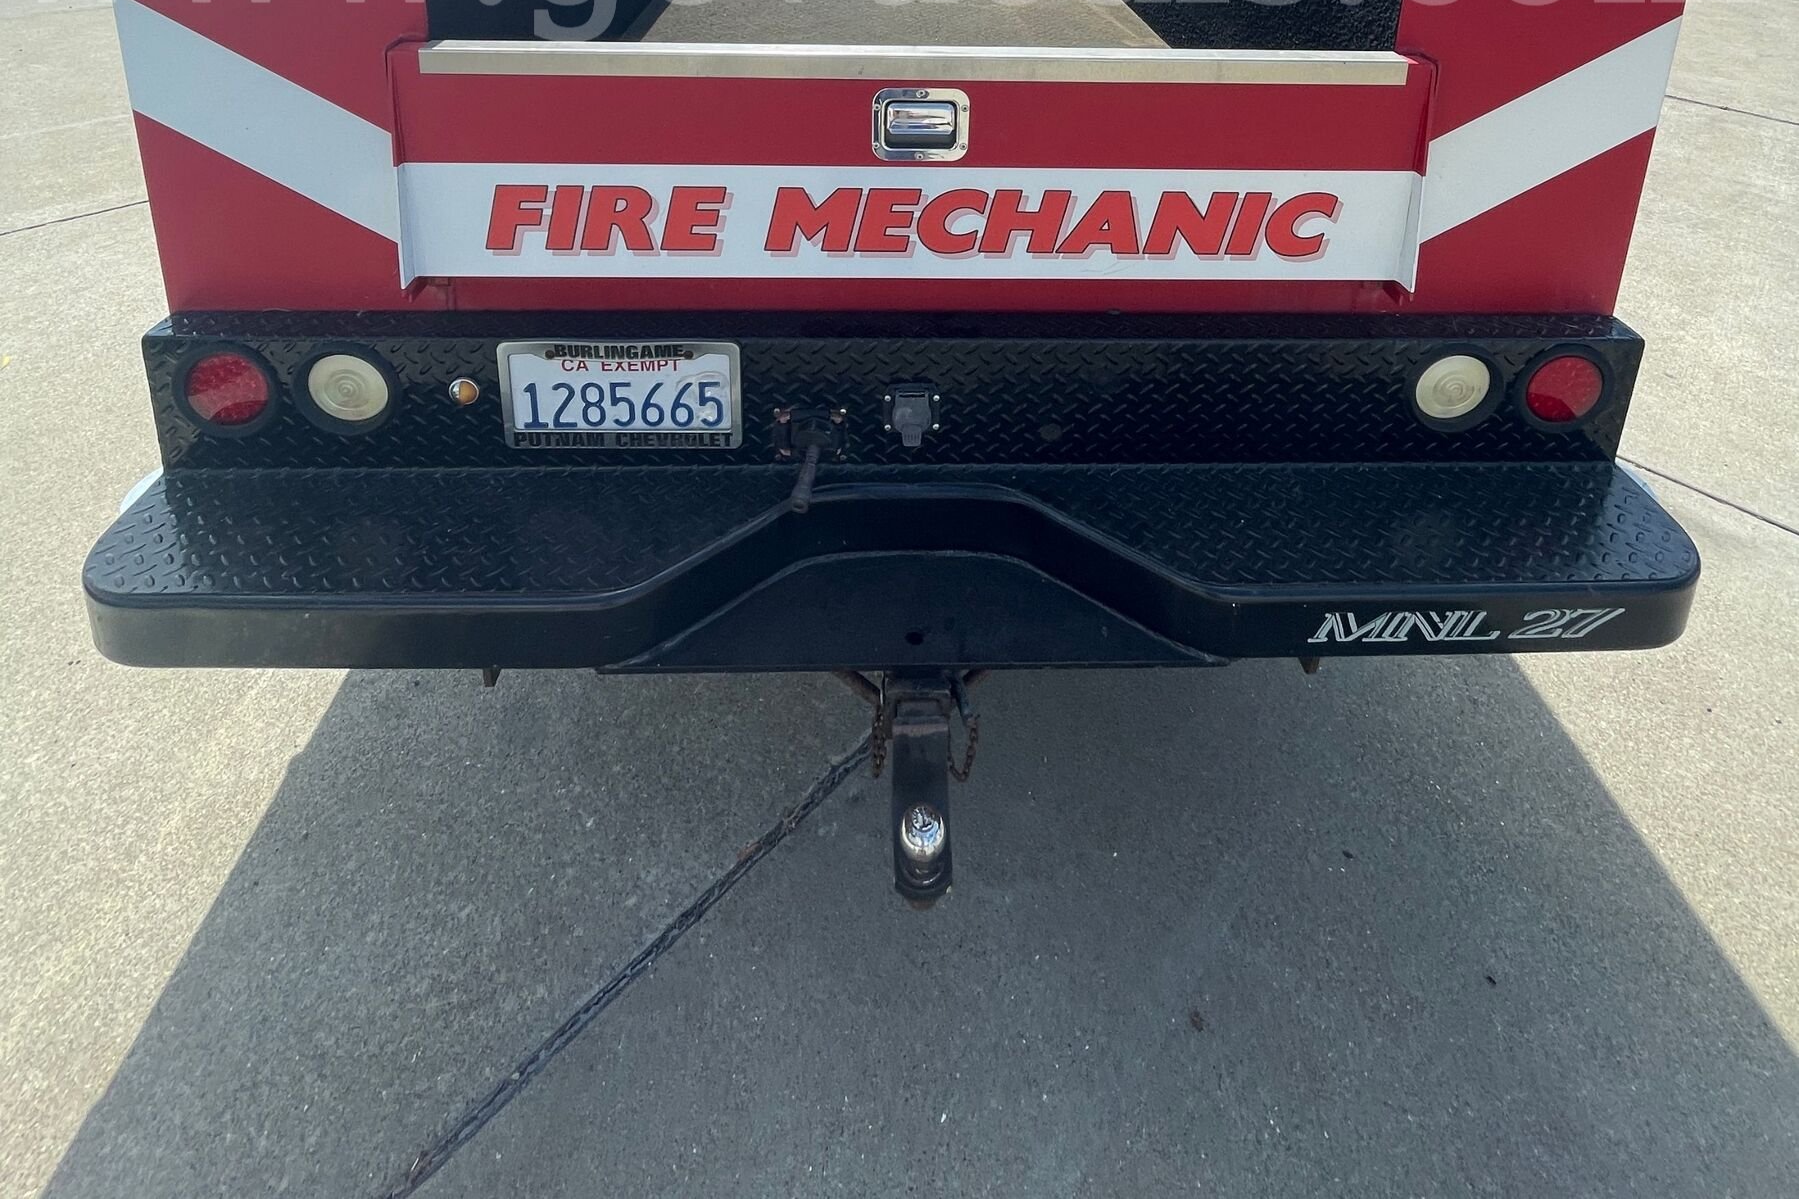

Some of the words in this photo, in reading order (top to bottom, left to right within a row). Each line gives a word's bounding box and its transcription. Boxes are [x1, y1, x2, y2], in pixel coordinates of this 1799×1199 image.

[485, 184, 734, 257] FIRE
[764, 186, 1341, 262] MECHANIC
[554, 344, 685, 360] BURLINGAME
[560, 359, 590, 372] CA
[601, 359, 682, 372] EXEMPT
[523, 382, 724, 429] 1285665
[513, 433, 606, 448] PUTNAM
[615, 433, 734, 448] CHEVROLET
[1508, 607, 1626, 640] 27
